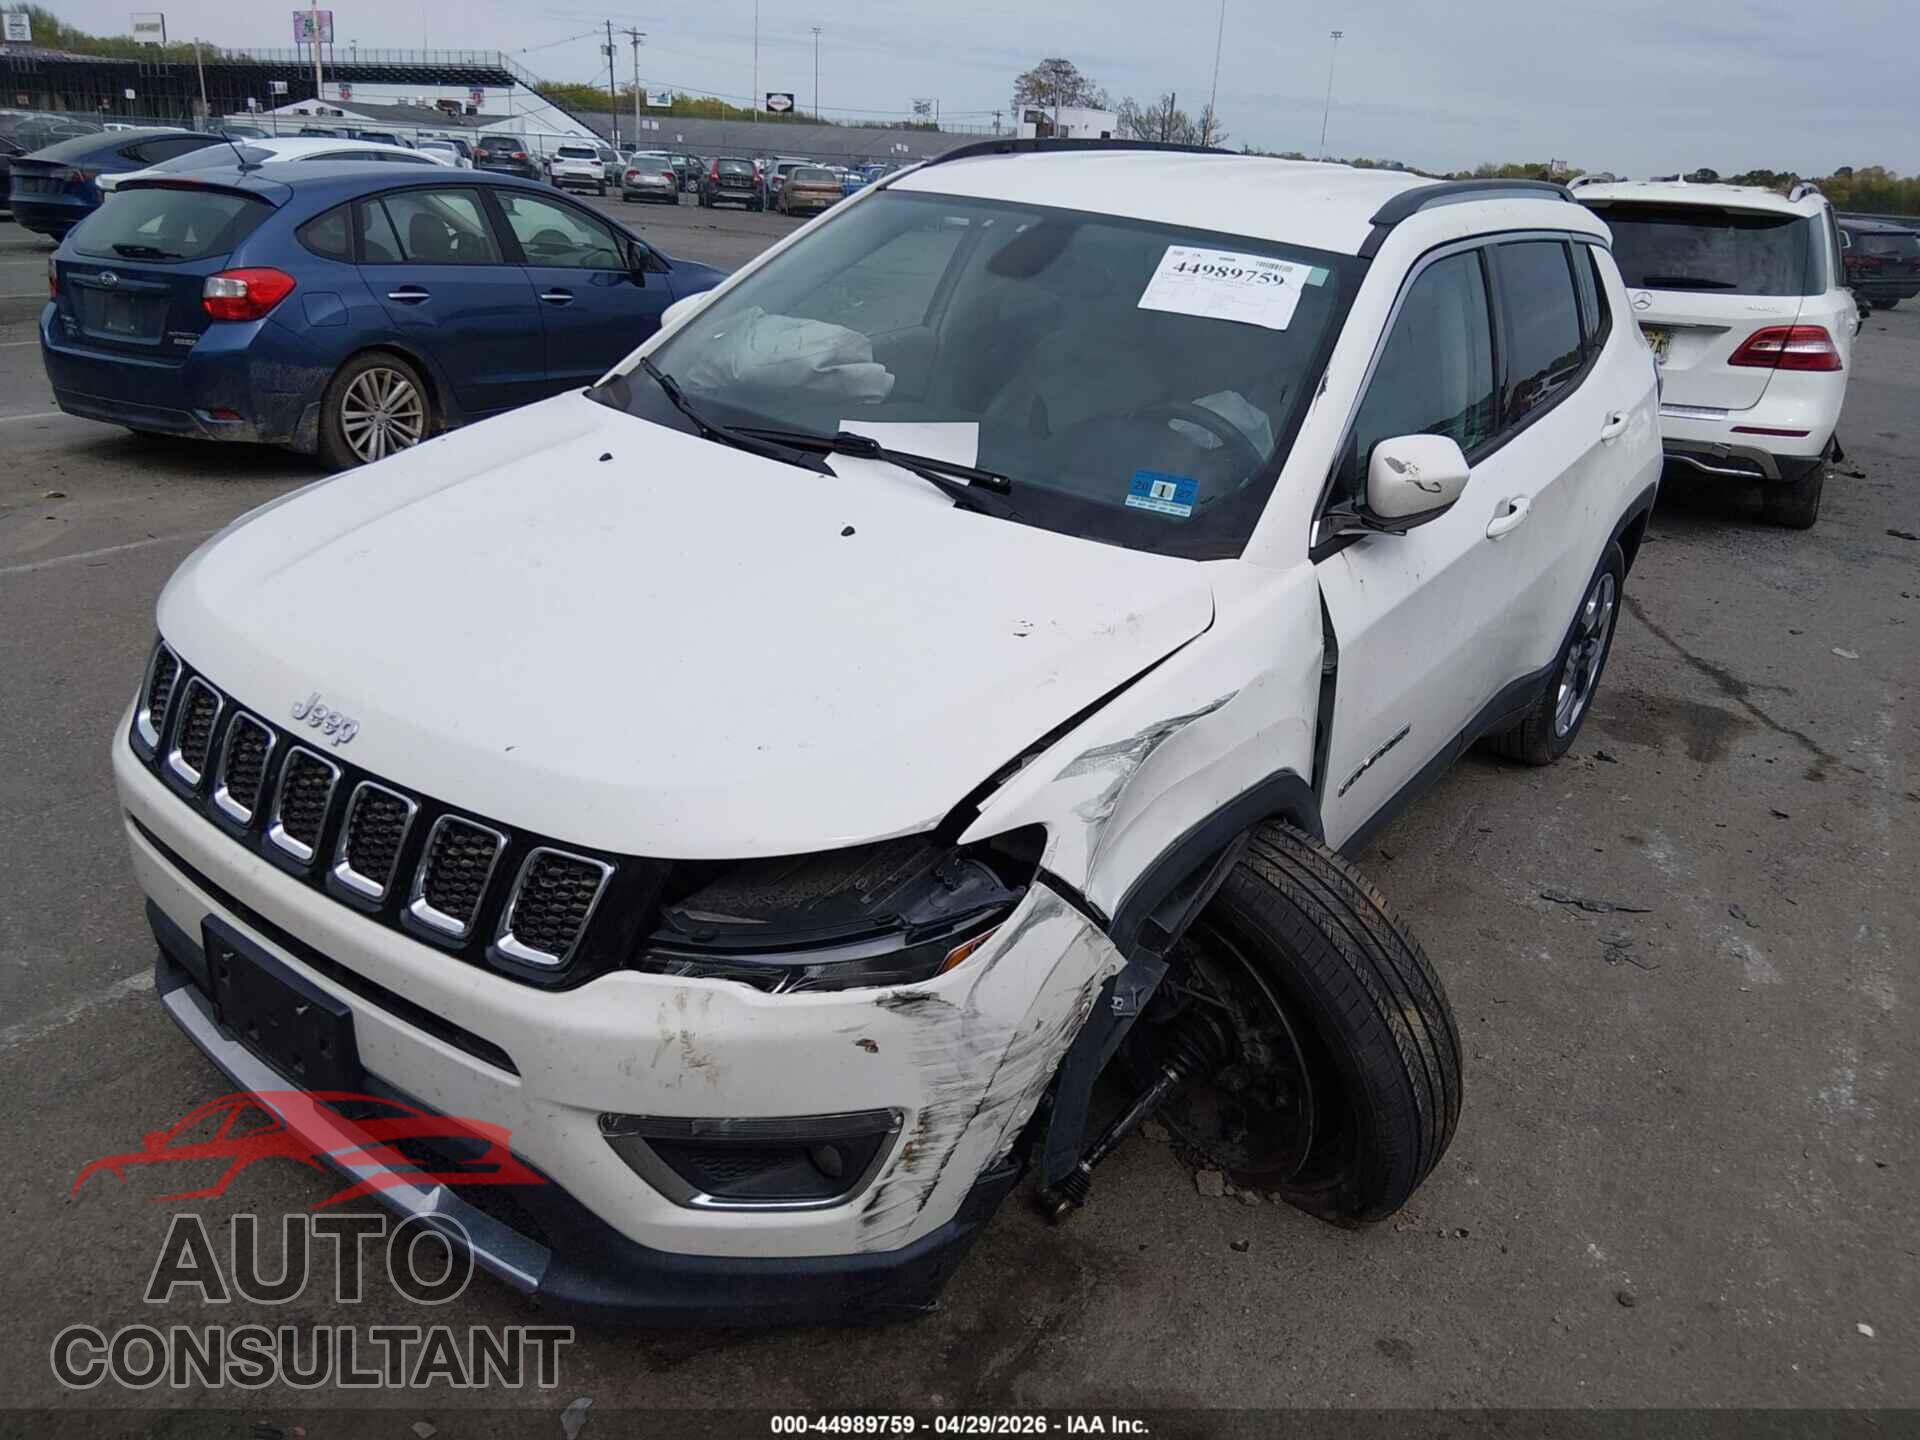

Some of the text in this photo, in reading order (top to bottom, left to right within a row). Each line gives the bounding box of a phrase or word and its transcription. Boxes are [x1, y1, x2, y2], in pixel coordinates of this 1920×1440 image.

[1172, 261, 1285, 286] 44989759
[1158, 484, 1166, 497] 1
[292, 691, 359, 746] Jeep
